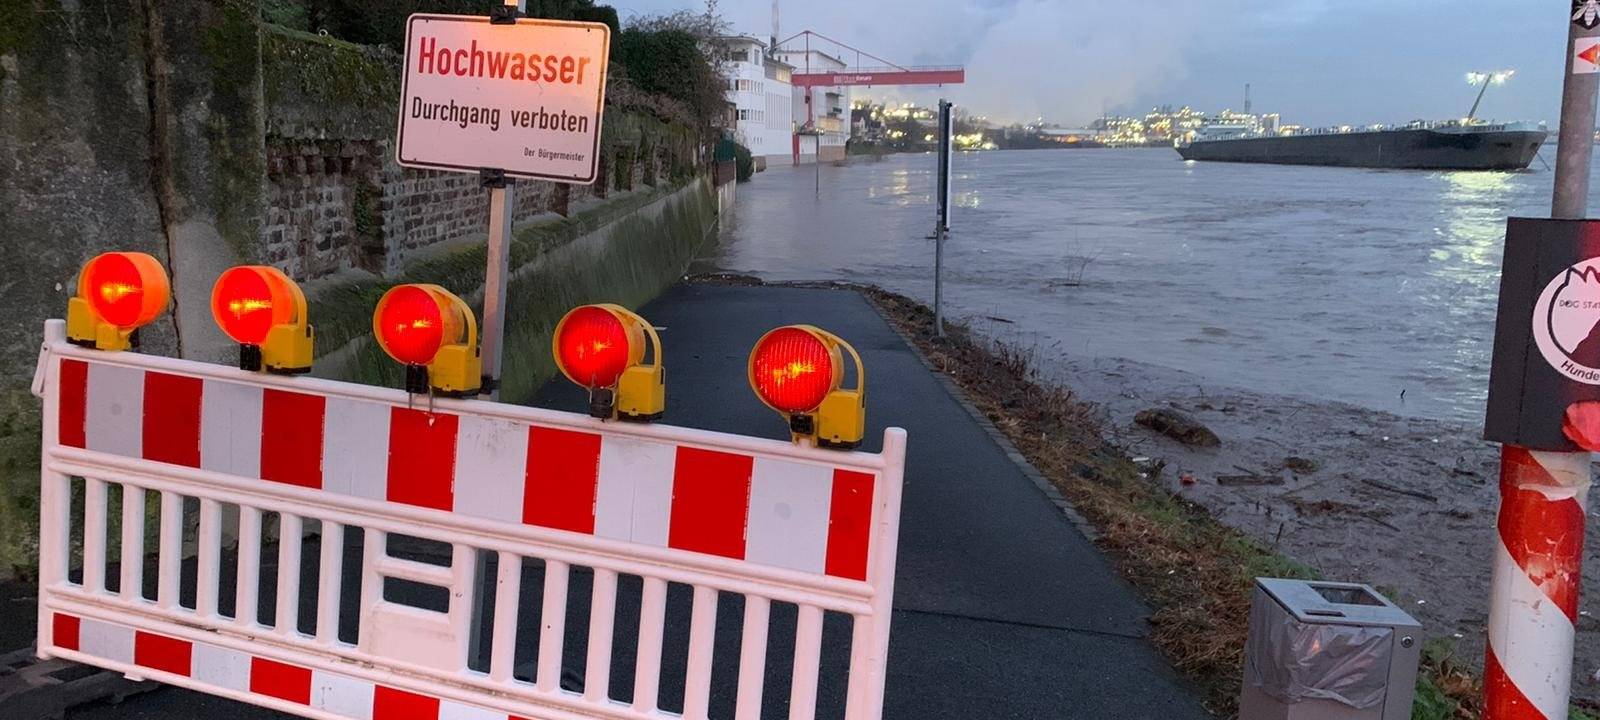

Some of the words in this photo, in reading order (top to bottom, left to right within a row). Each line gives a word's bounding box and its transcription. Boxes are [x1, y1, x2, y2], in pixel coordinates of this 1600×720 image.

[418, 36, 590, 85] Hochwasser
[411, 96, 500, 131] Durchgang
[511, 106, 588, 133] verboten
[524, 147, 536, 157] Der
[538, 147, 585, 162] Bürgermeister
[1559, 300, 1580, 309] DOG
[1560, 360, 1600, 381] Hunde
